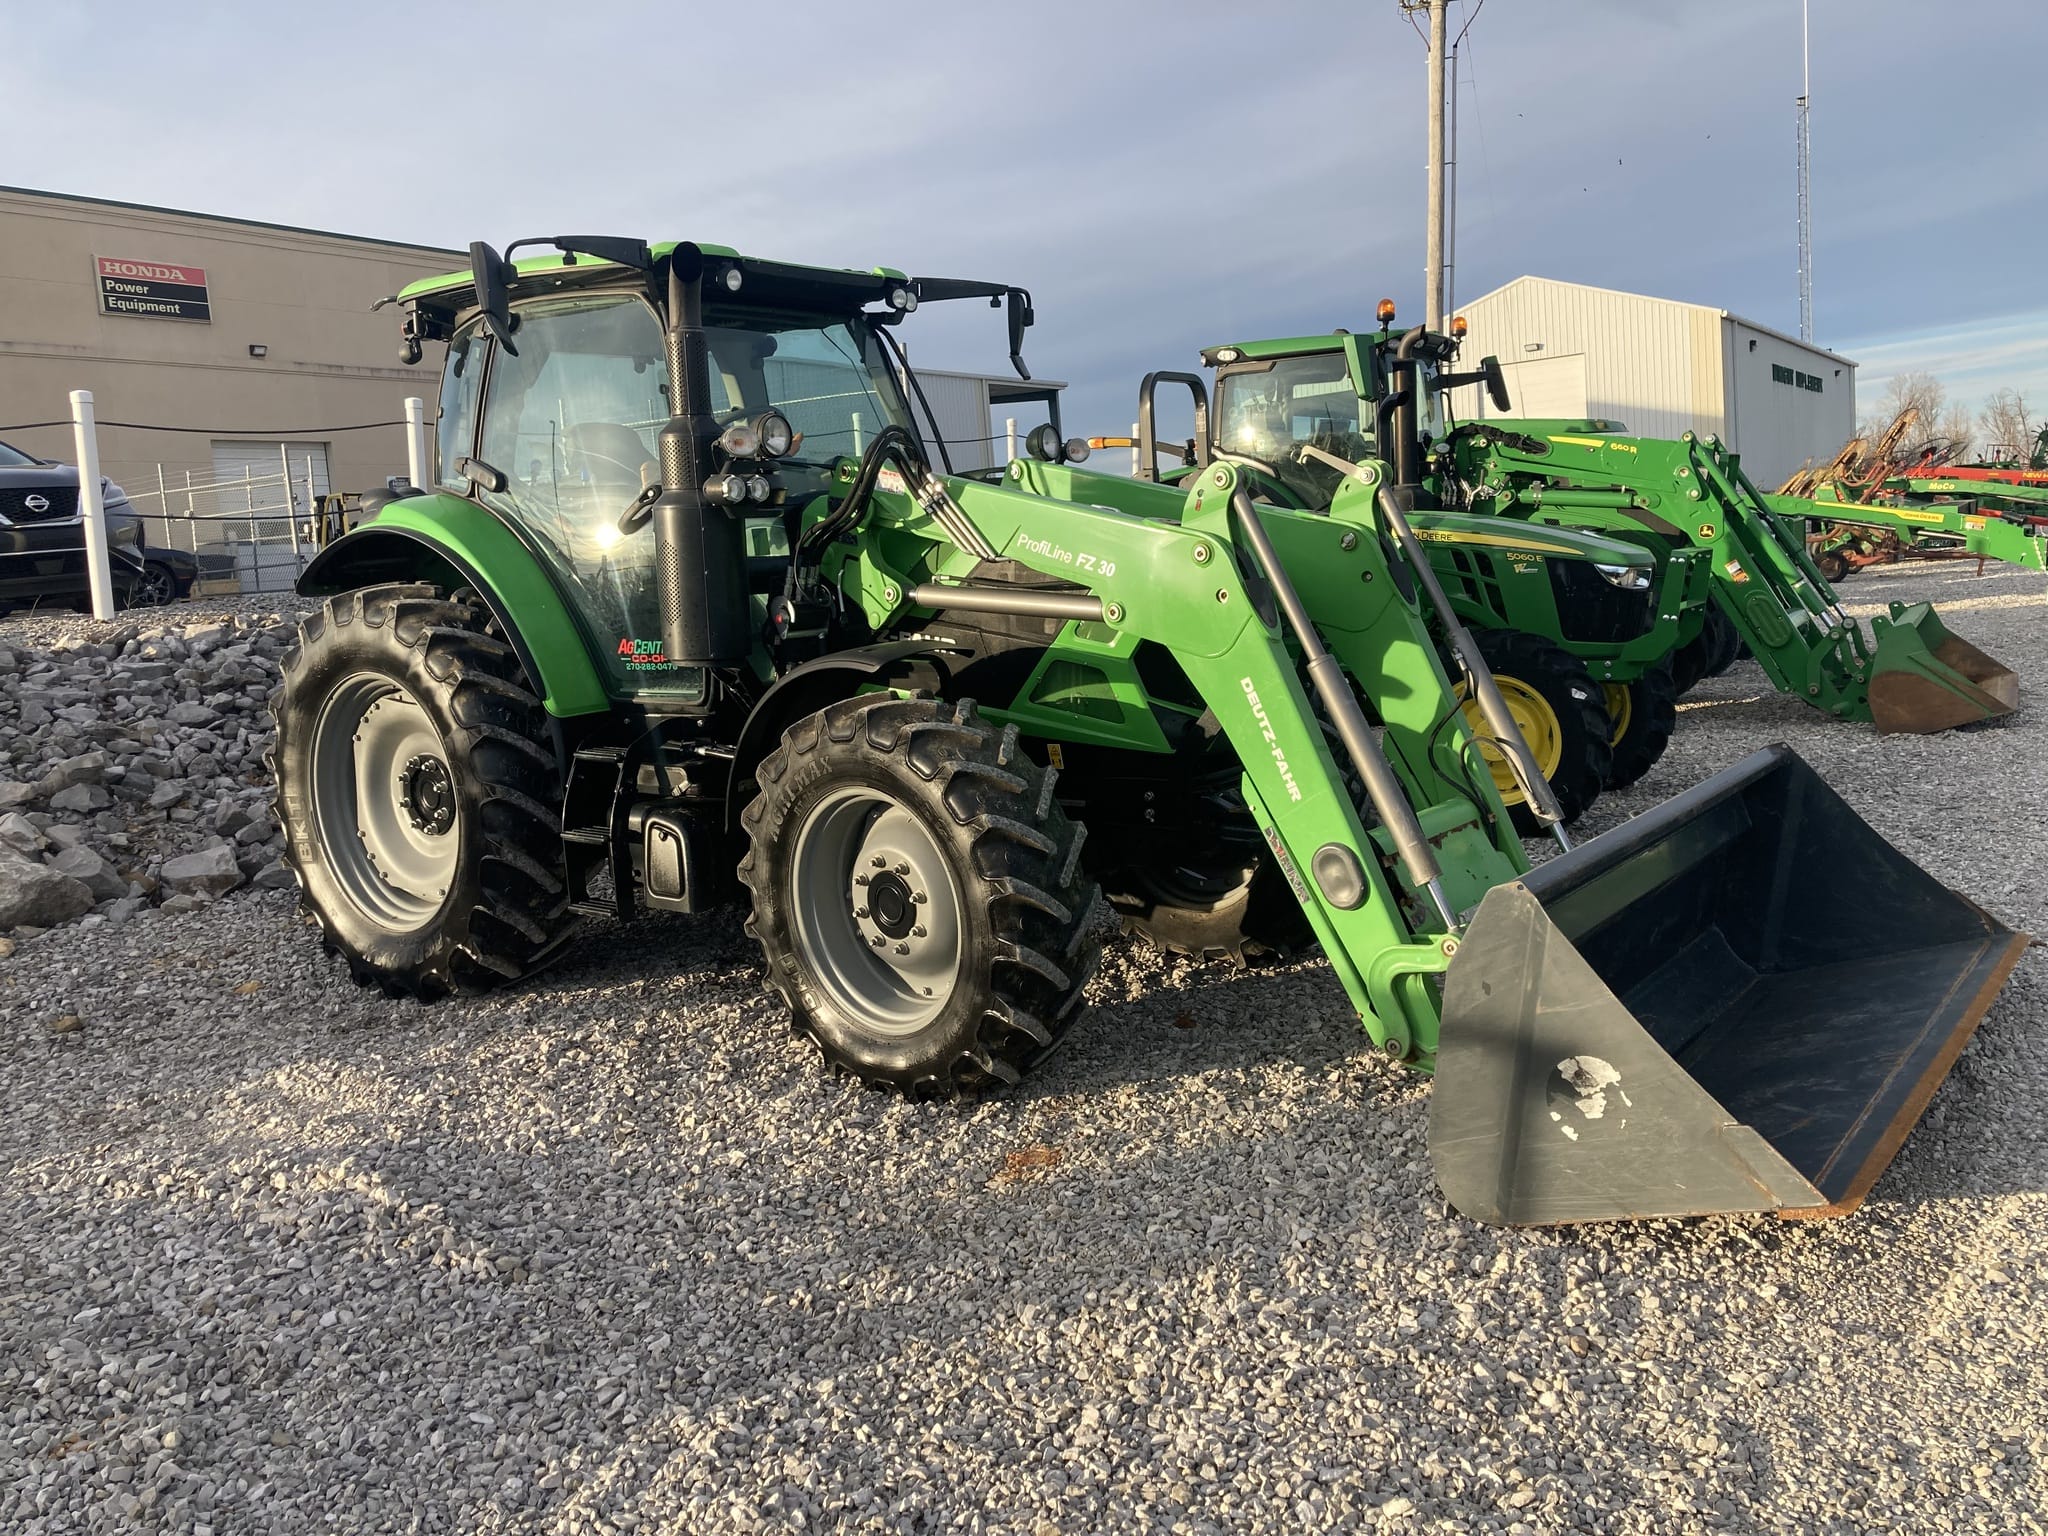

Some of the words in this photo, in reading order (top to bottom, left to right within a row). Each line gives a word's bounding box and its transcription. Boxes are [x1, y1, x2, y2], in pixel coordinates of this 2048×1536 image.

[103, 261, 186, 281] HONDA
[105, 279, 149, 295] Power
[108, 296, 181, 314] Equipment
[1630, 446, 1637, 455] R
[1928, 482, 1955, 490] MoCo
[1421, 531, 1453, 541] DEERE
[1016, 533, 1072, 564] ProfiLine
[1075, 552, 1097, 571] FZ
[1098, 560, 1116, 577] 30
[1506, 552, 1535, 562] 5060
[1535, 555, 1544, 563] E
[1240, 676, 1302, 803] DEUTZ-FAHR
[285, 796, 313, 862] BKT
